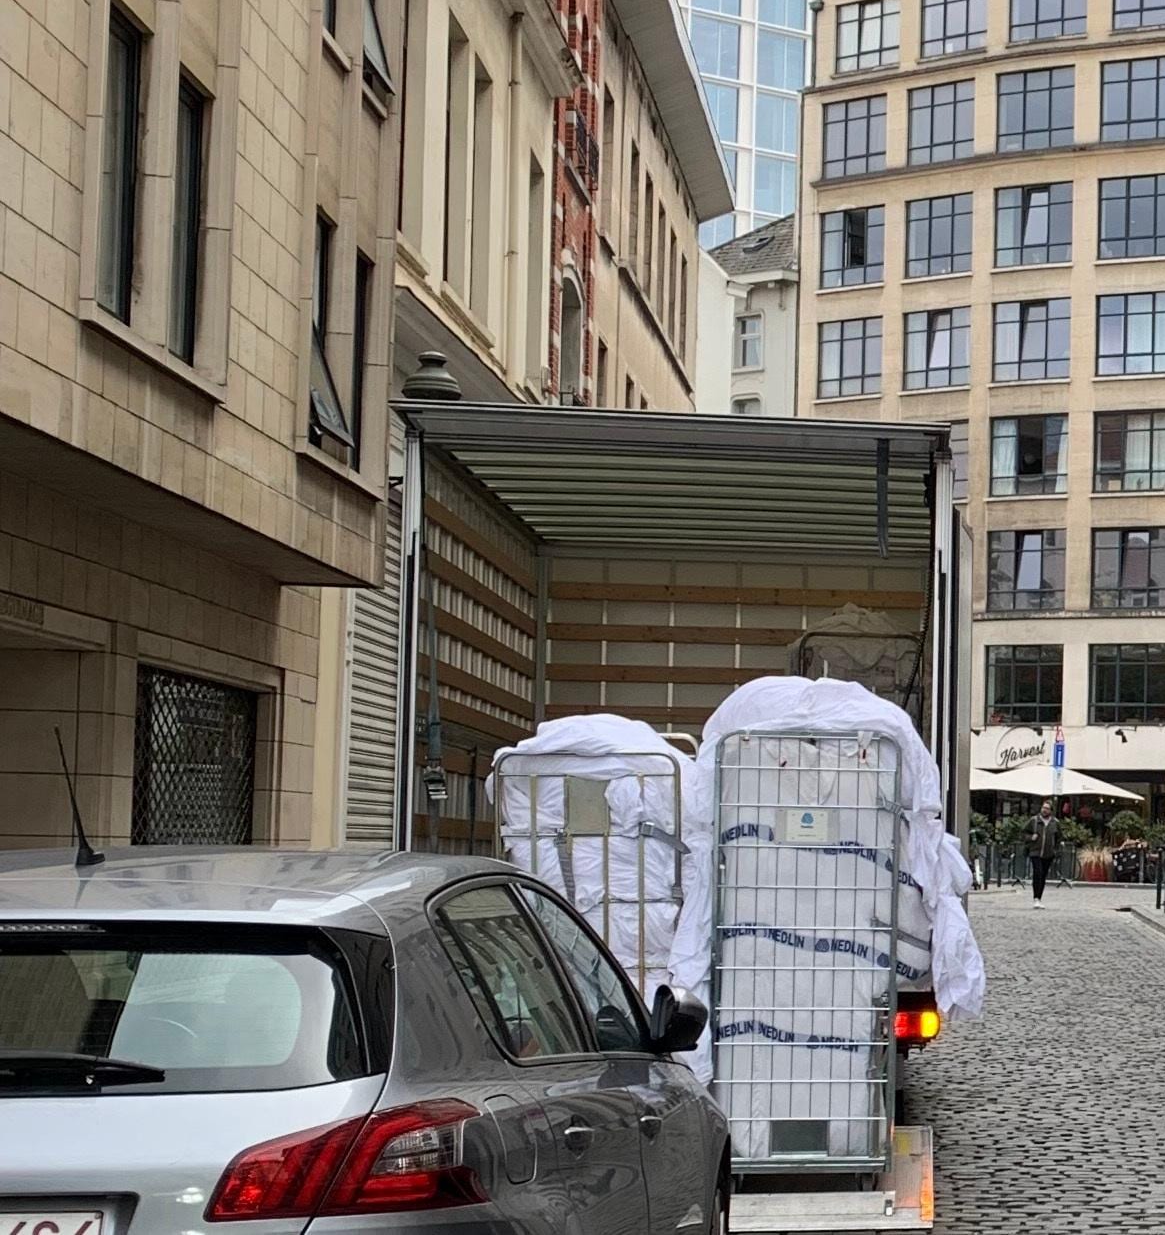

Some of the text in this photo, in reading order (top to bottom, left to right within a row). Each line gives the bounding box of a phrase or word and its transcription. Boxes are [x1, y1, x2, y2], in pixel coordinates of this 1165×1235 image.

[1000, 740, 1046, 769] Harvest
[721, 823, 759, 844] NEDLIN
[768, 928, 805, 949] NEDLIN
[830, 938, 869, 959] NEDLIN
[717, 1020, 755, 1039] NEDLIN
[757, 1020, 795, 1043] NEDLIN
